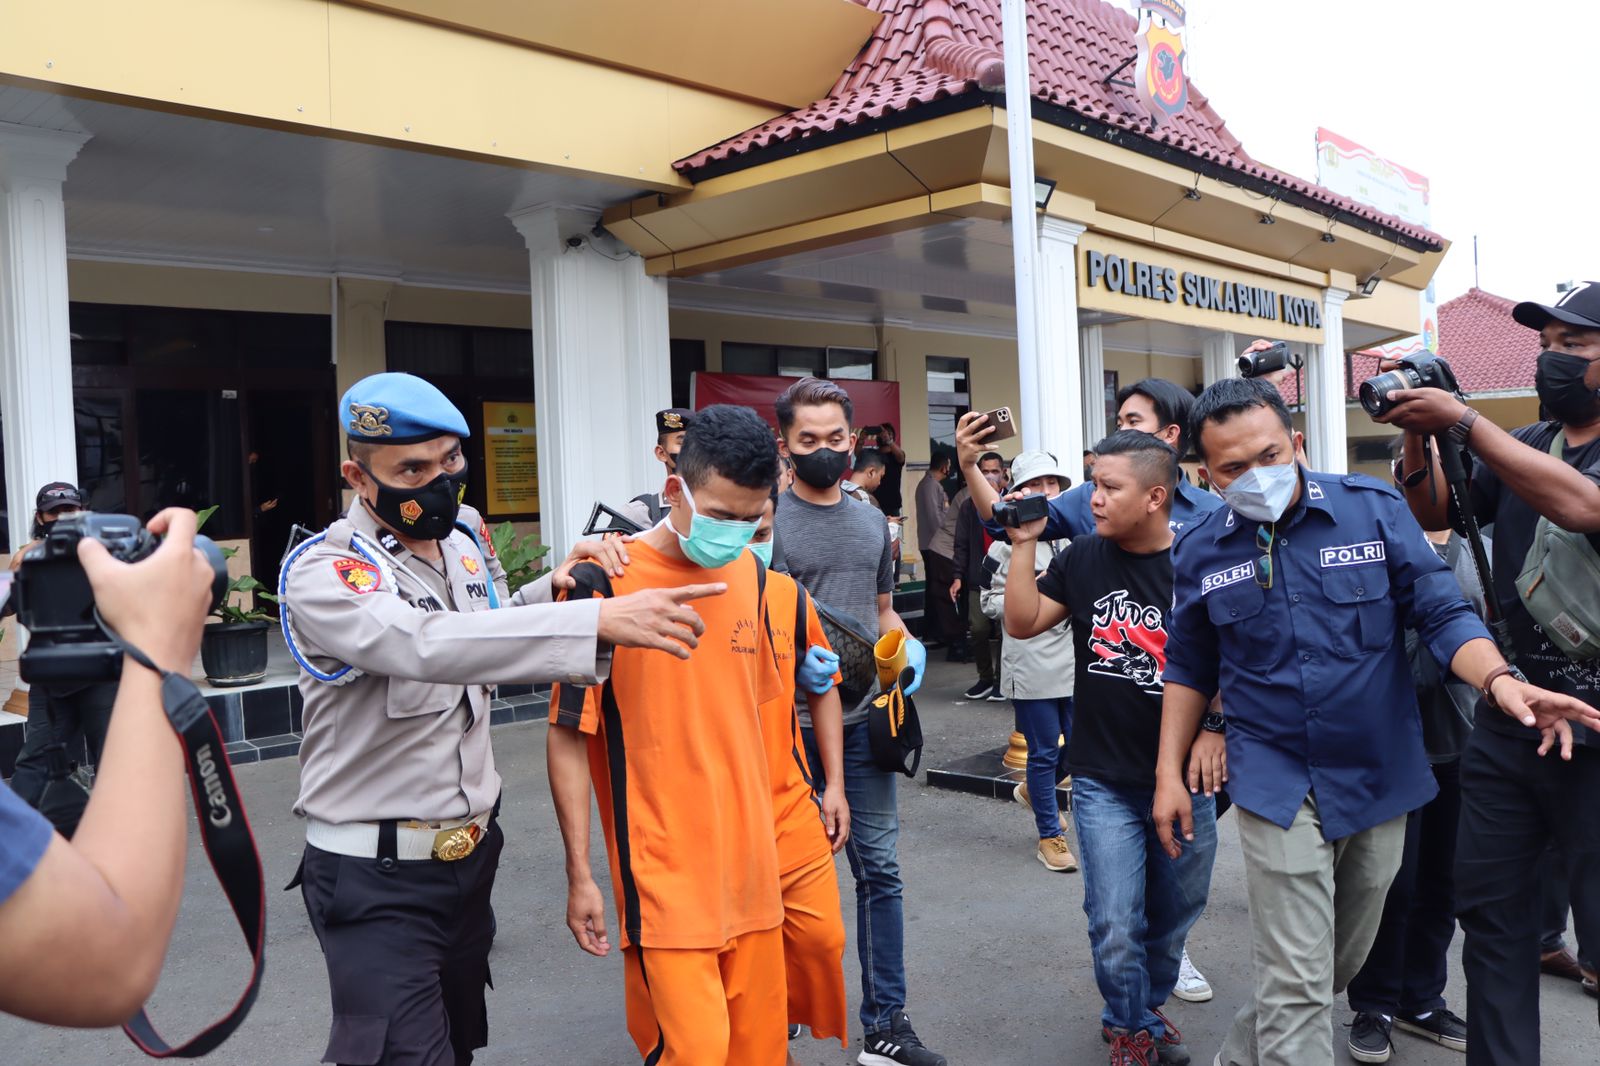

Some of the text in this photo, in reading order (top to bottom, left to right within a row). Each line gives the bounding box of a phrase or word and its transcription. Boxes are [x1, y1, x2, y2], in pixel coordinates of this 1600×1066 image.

[1087, 250, 1323, 328] POLRES SUKABUMI KOTA
[402, 518, 415, 526] TNI
[1324, 544, 1382, 563] POLRI
[1204, 566, 1251, 589] SOLEH
[466, 584, 488, 598] POLI
[1092, 589, 1162, 632] JUDO
[197, 743, 232, 827] Canon
